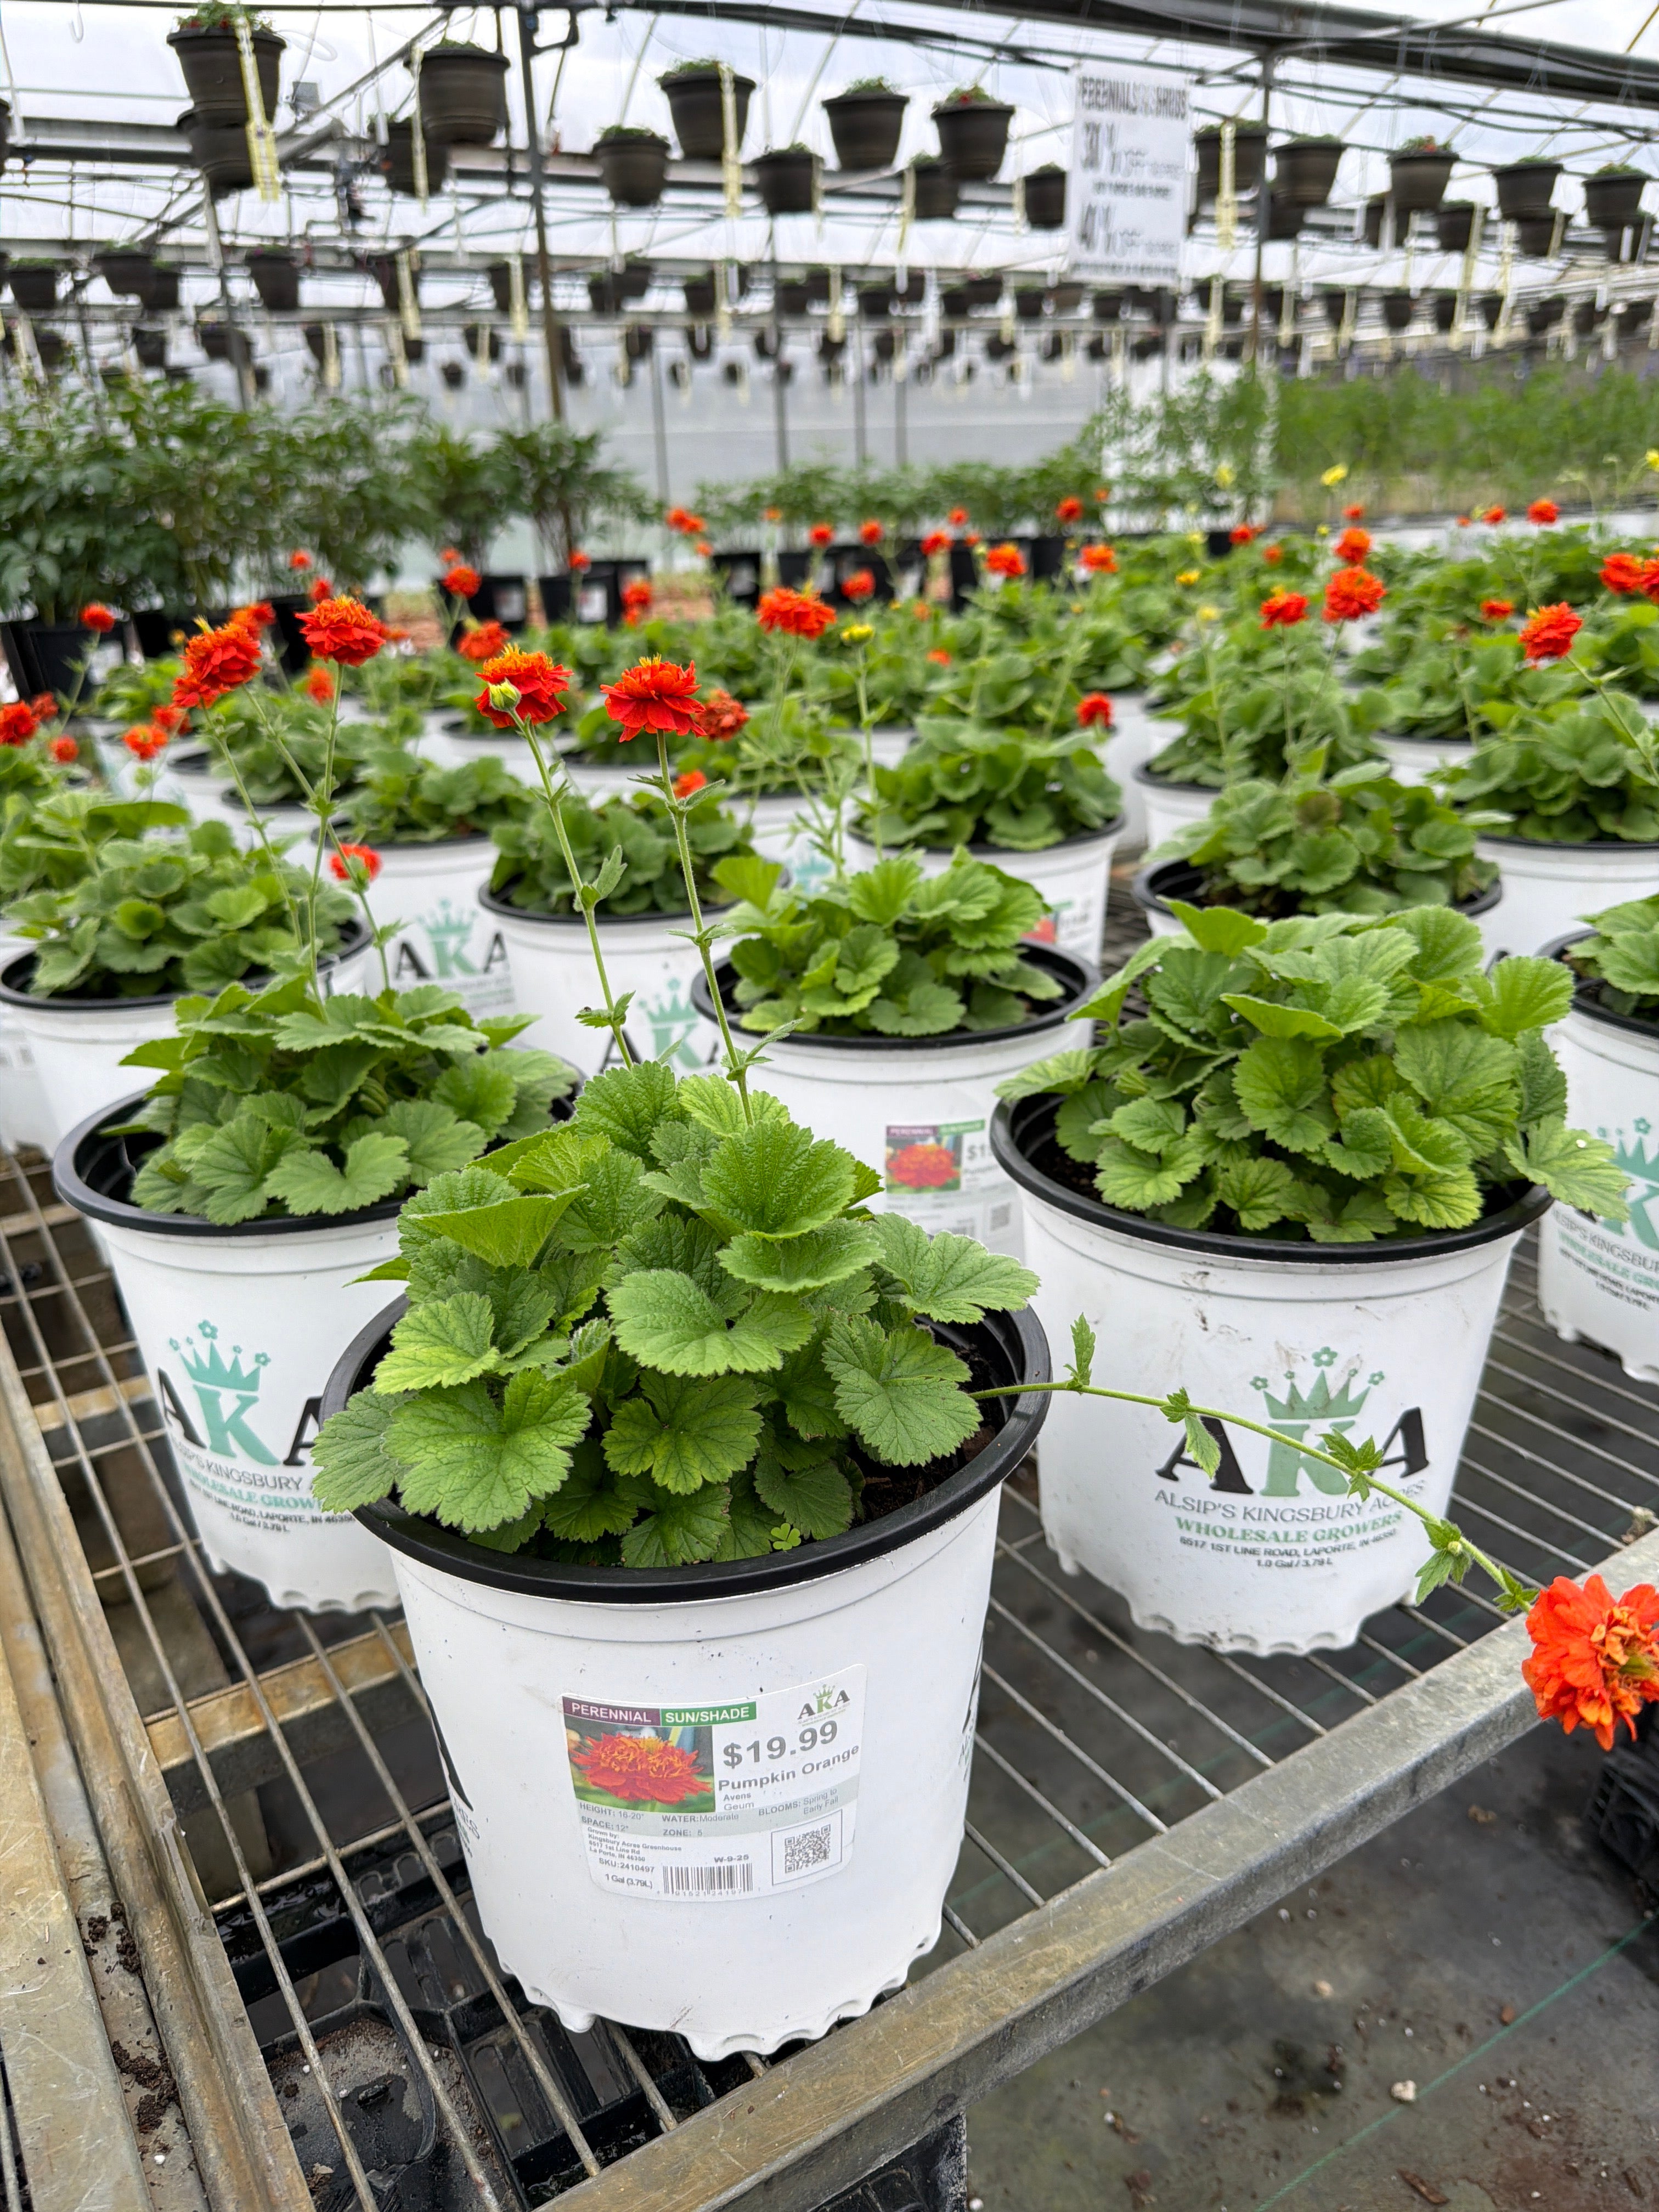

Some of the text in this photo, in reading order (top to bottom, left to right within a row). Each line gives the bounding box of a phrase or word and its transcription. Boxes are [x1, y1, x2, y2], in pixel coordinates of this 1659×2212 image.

[394, 930, 509, 981] AKA
[600, 1022, 720, 1074] AK
[1154, 1406, 1430, 1497] AKA
[206, 1459, 303, 1491] KINGSBURY
[1154, 1480, 1426, 1522] ALSIP'S KINGSBURY ACES
[1175, 1510, 1403, 1543] WHOLESALE GROWERS
[1210, 1543, 1232, 1553] 1ST
[1234, 1545, 1261, 1556] LINE
[1263, 1548, 1301, 1557] ROAD,
[1303, 1542, 1356, 1556] LAPORTE,
[1359, 1538, 1370, 1547] IN
[1274, 1560, 1293, 1568] Gal
[572, 1702, 750, 1723] PERENNIAL SUN/SHADE
[797, 1689, 850, 1720] AKA
[723, 1720, 838, 1769] $19.99
[719, 1745, 860, 1791] Pumpkin Orange
[723, 1792, 752, 1802] Avens
[724, 1802, 754, 1811] Geum
[758, 1801, 801, 1816] BLOOMS:
[803, 1791, 828, 1805] Spring
[803, 1796, 838, 1815] Early Fall
[579, 1802, 616, 1816] HEIGHT:
[582, 1815, 614, 1830] SPACE:
[588, 1826, 608, 1836] Grown
[588, 1833, 682, 1852] Kingsbury Acres Greenhouse
[616, 1846, 630, 1854] Line
[599, 1848, 617, 1858] Porte,
[612, 1875, 625, 1884] Gal
[627, 1877, 653, 1889] (3.79L)
